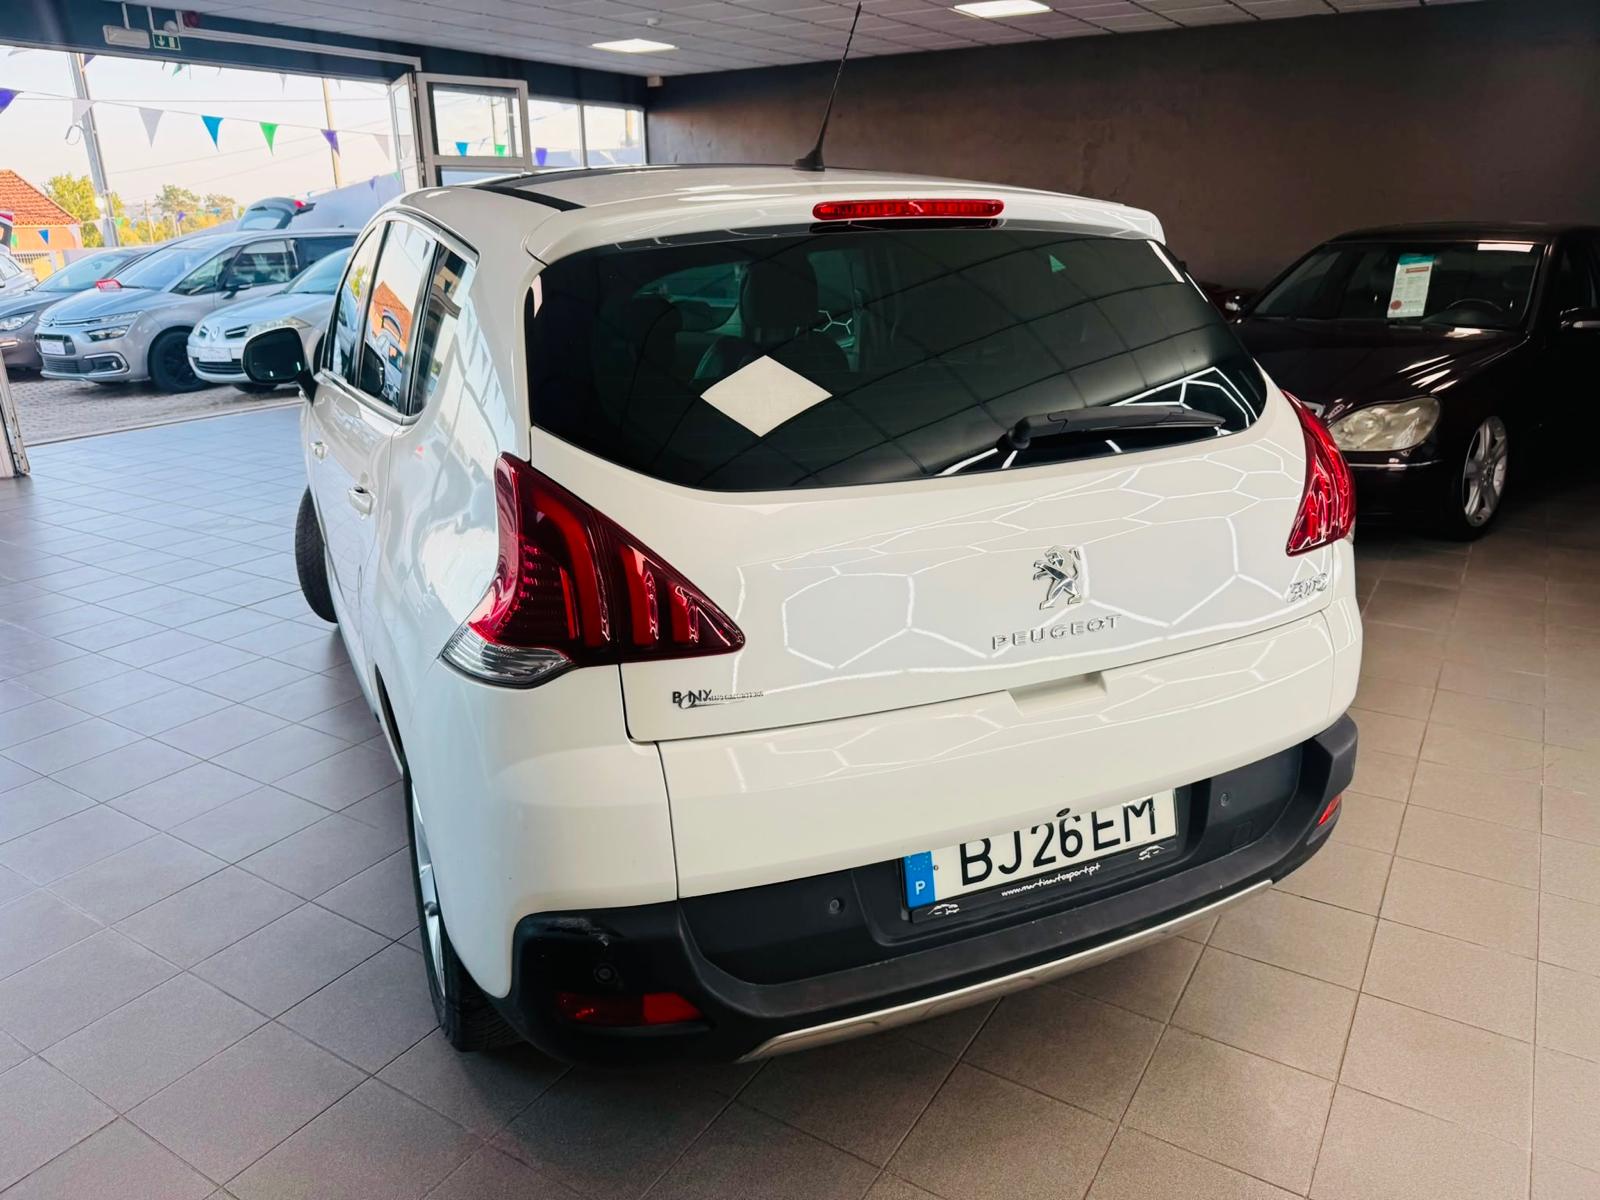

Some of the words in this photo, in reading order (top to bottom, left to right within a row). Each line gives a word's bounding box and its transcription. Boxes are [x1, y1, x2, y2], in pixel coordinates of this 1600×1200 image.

[992, 614, 1121, 650] PEUGEOT
[959, 797, 1156, 886] BJ26EM
[914, 880, 926, 895] P
